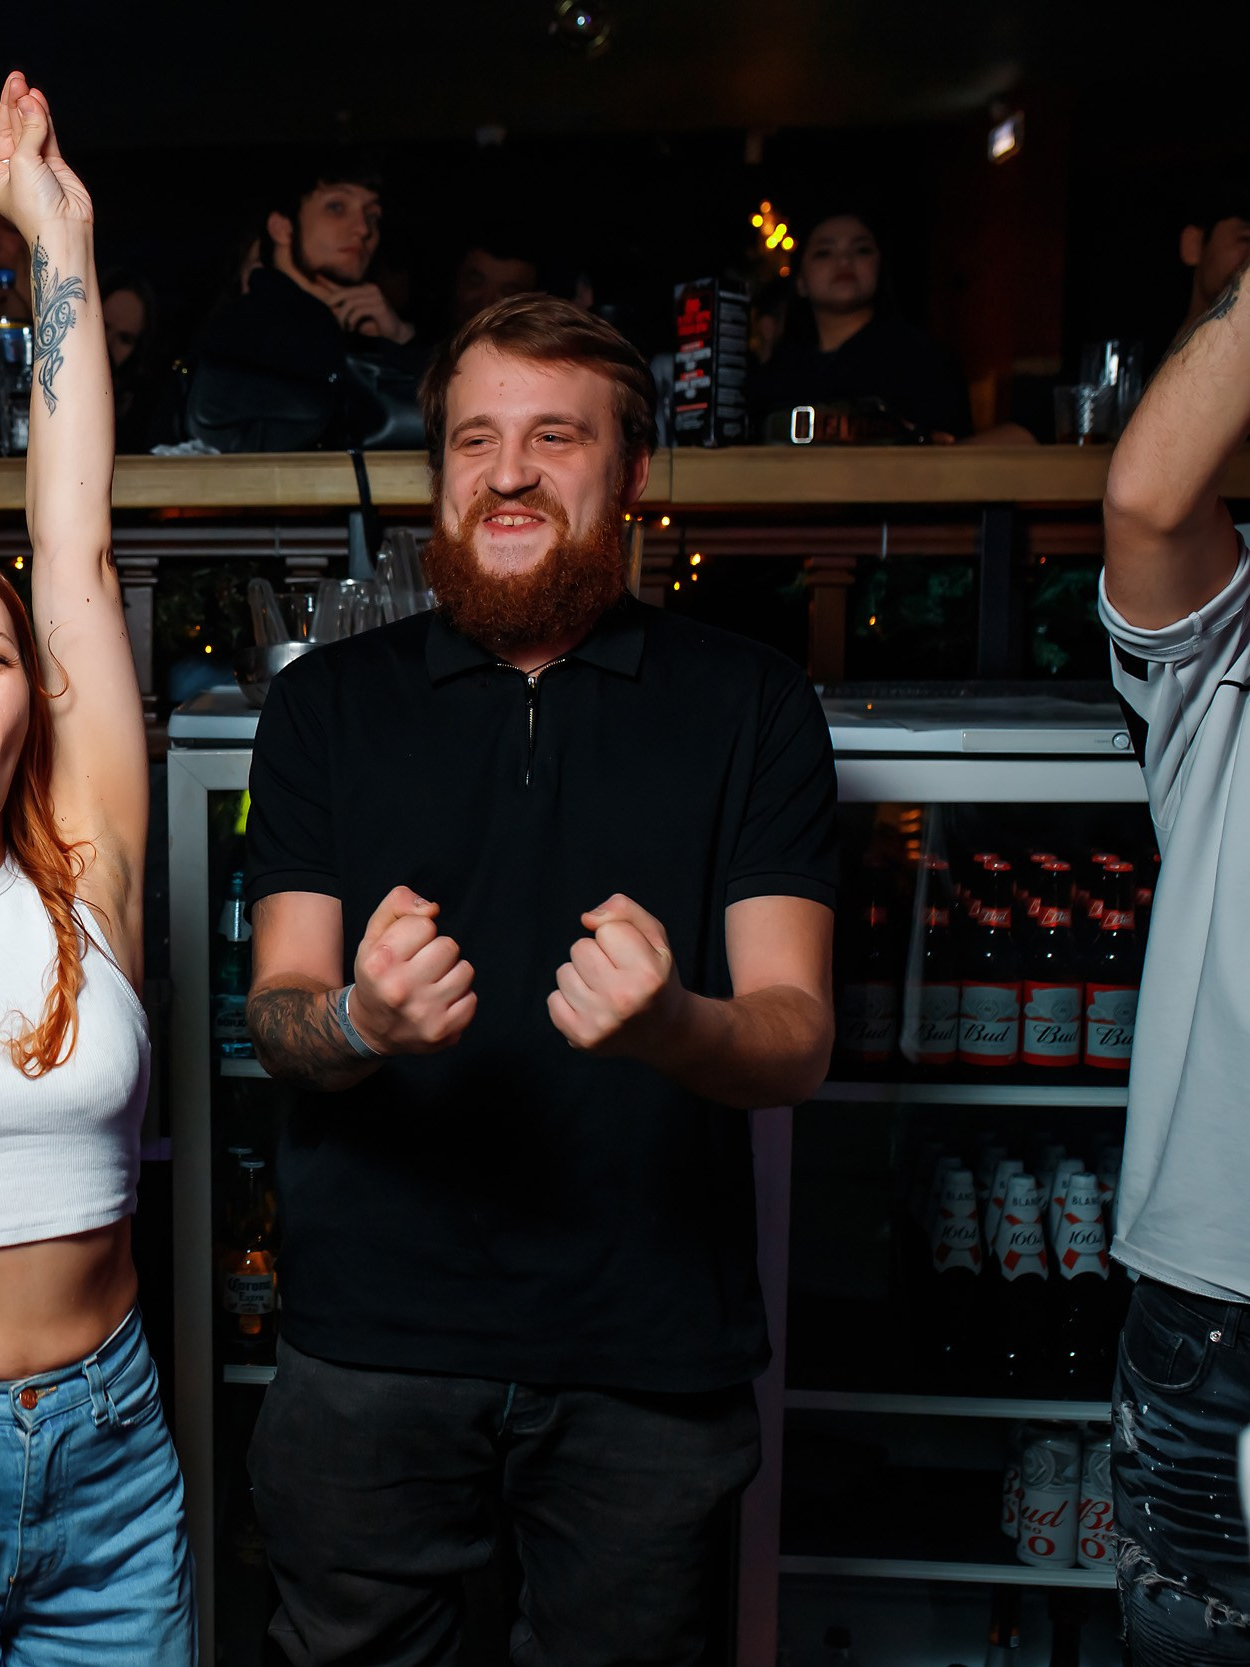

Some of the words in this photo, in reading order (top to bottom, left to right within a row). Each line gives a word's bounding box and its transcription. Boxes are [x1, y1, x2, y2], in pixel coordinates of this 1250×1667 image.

[962, 1023, 1010, 1043] Bud
[1033, 1024, 1081, 1044] Bud
[1096, 1026, 1134, 1046] Bu
[1021, 1500, 1069, 1528] ud
